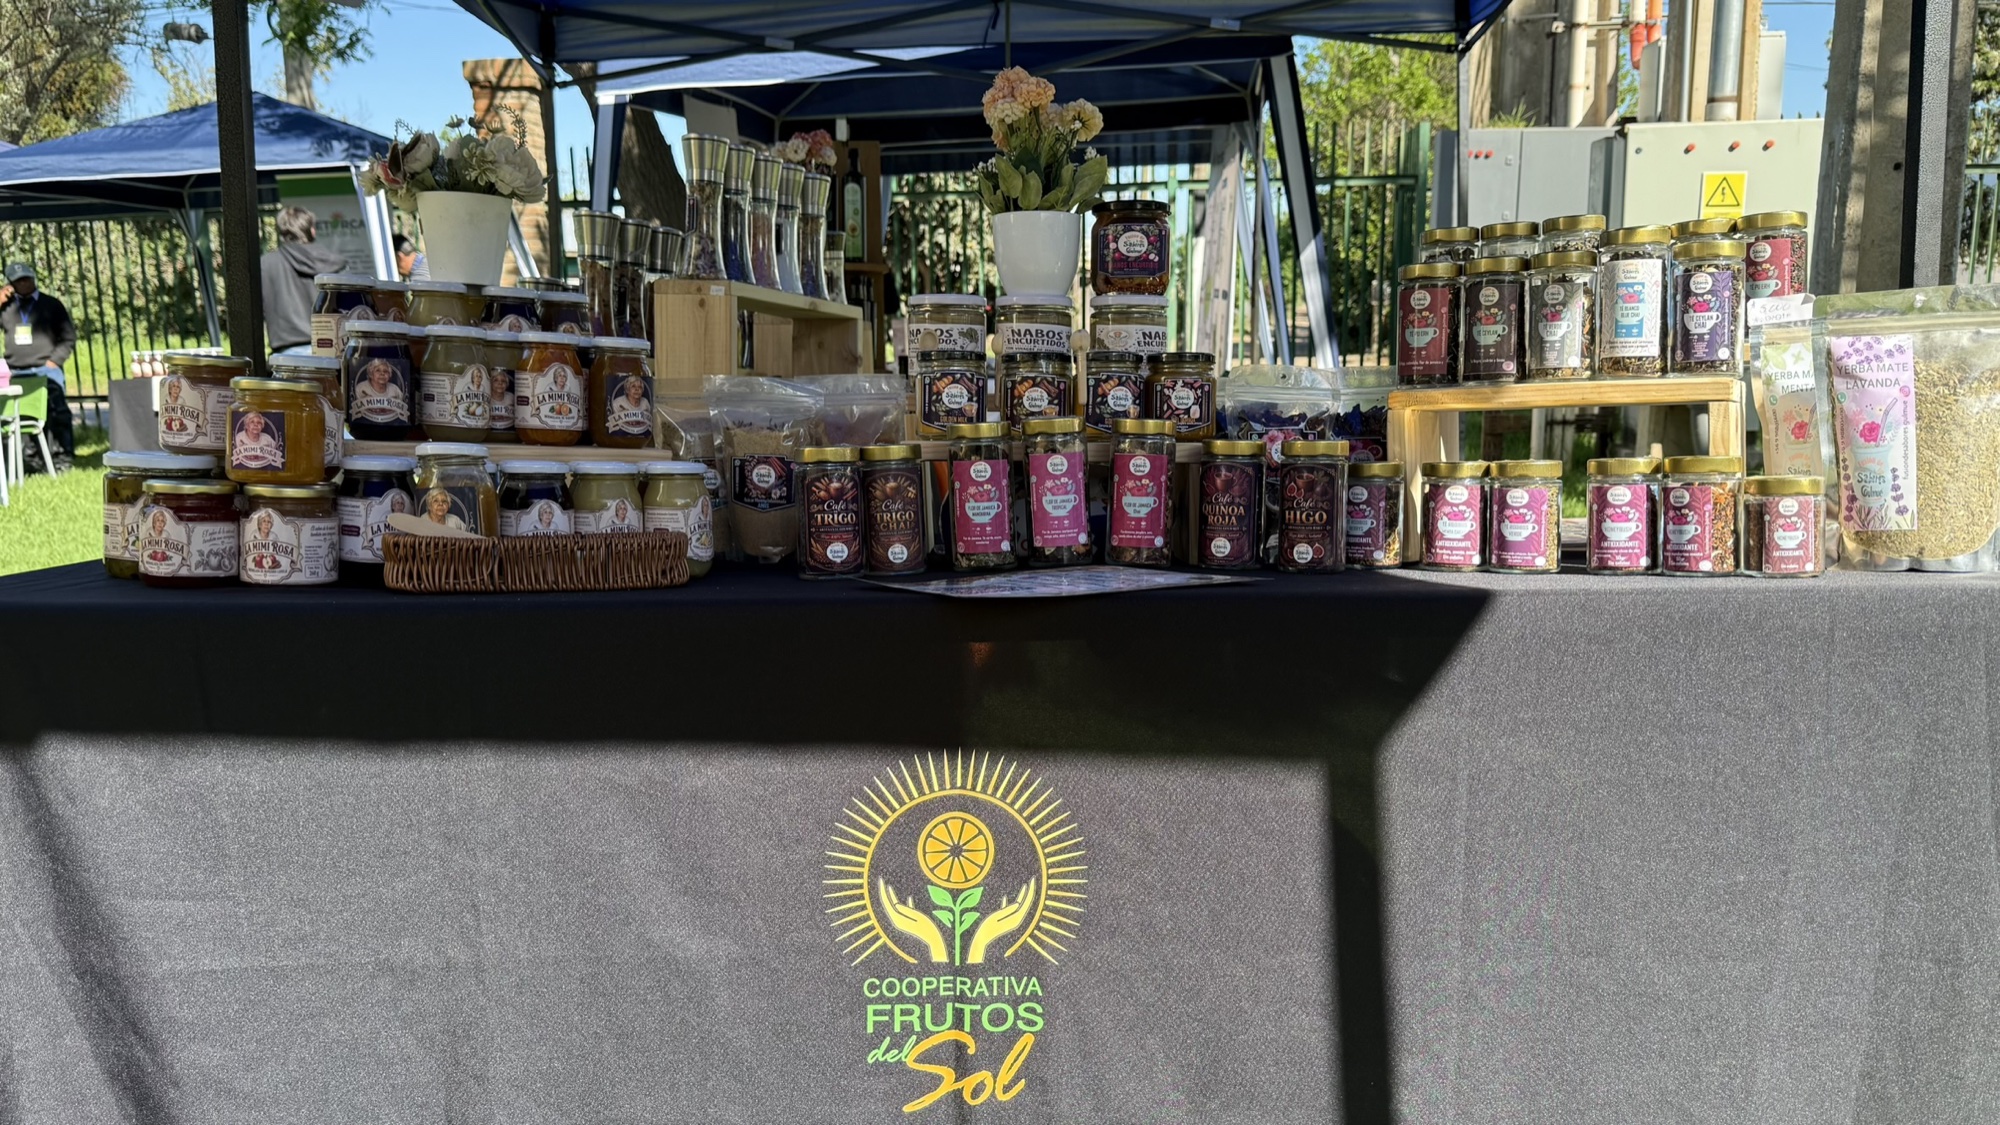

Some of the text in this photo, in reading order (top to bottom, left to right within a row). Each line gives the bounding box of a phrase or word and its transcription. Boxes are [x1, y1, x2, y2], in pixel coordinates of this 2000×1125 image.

[1011, 328, 1065, 341] NABOS
[1142, 331, 1167, 340] NAB
[1007, 338, 1066, 349] ENCURTIDOS
[1836, 362, 1909, 375] YERBA MATE
[1767, 371, 1800, 381] YERBA
[1781, 383, 1816, 394] MENTA
[1845, 378, 1901, 390] LAVANDA
[366, 398, 385, 406] MIMI
[456, 392, 481, 403] LA MIMI
[537, 395, 546, 405] LA
[547, 392, 566, 403] MIMI
[179, 405, 200, 422] ROSA
[624, 411, 640, 419] MIMI
[243, 446, 258, 454] MIMI
[258, 446, 277, 458] ROSA
[1212, 492, 1233, 505] Café
[1294, 497, 1315, 509] Café
[824, 499, 847, 513] Café
[882, 499, 904, 512] Café
[1202, 503, 1245, 516] QUINOA
[814, 512, 856, 526] TRIGO
[875, 511, 914, 523] TRIGO
[1208, 515, 1237, 526] ROJA
[1285, 510, 1328, 524] HIGO
[371, 526, 382, 535] LA
[880, 521, 911, 531] CHAI
[147, 538, 163, 548] MIMI
[163, 538, 185, 554] ROSA
[244, 543, 252, 554] LA
[252, 541, 270, 551] MIMI
[271, 541, 295, 558] ROSA
[863, 976, 1043, 998] COOPERATIVA
[866, 1002, 1044, 1033] FRUTOS
[867, 1035, 917, 1064] del
[903, 1029, 1035, 1113] Sol
